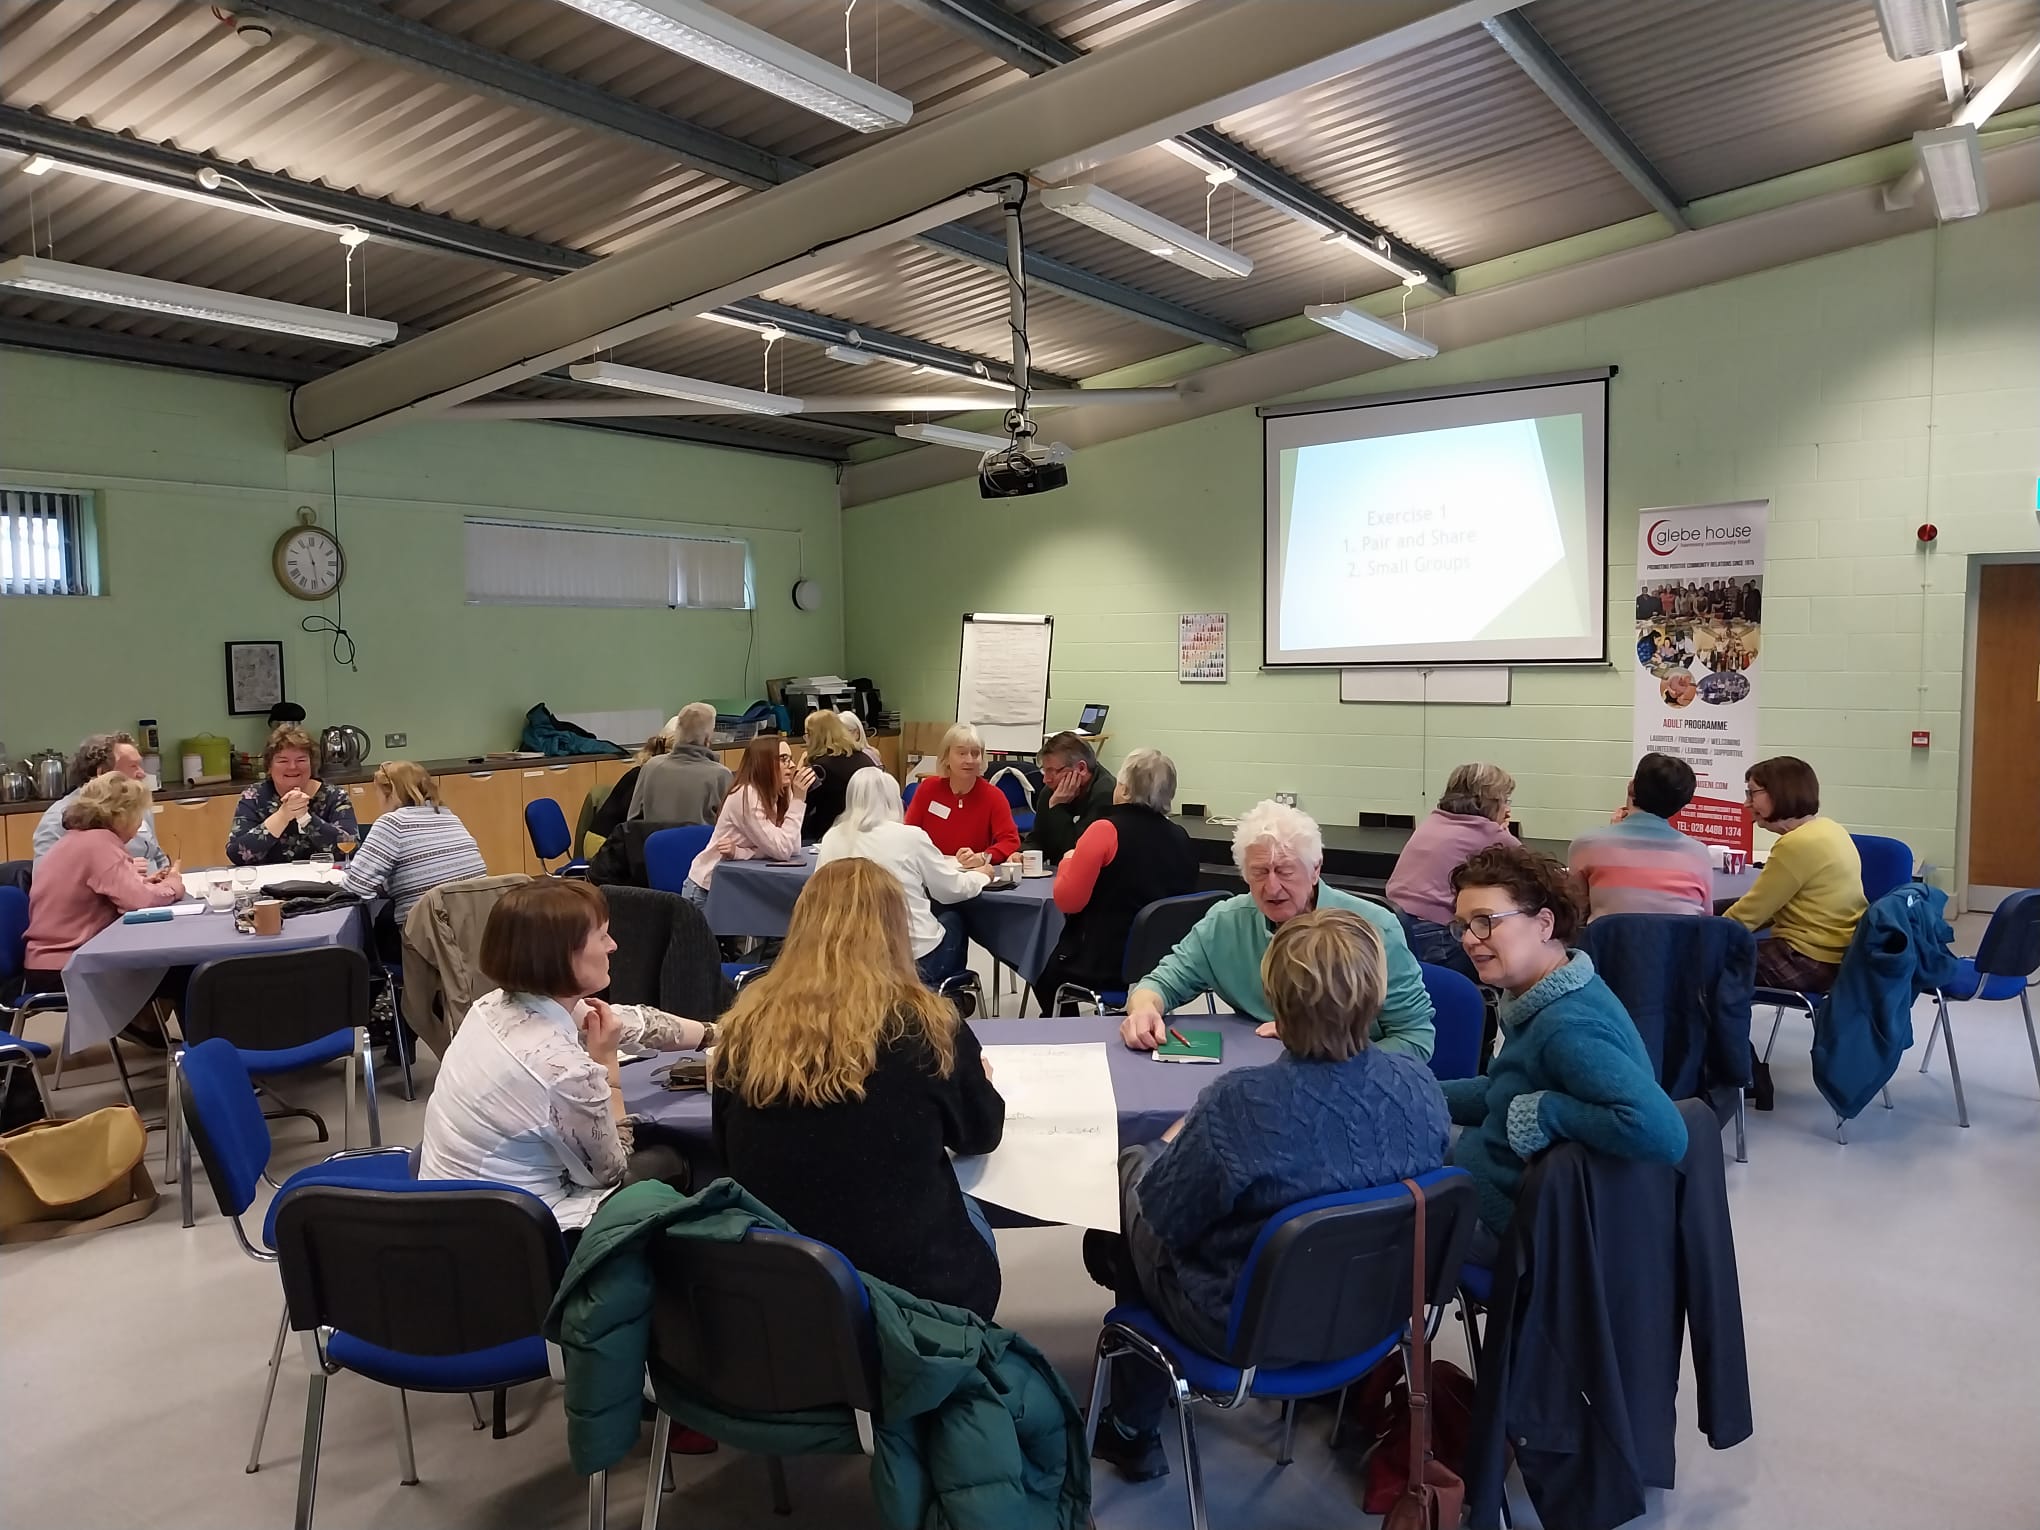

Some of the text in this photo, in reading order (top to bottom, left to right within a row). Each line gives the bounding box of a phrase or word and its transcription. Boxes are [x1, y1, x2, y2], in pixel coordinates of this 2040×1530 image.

[1367, 504, 1447, 527] Exercise 1
[1362, 534, 1391, 552] Pair
[1397, 530, 1425, 549] and
[1431, 529, 1479, 546] Share
[1657, 525, 1752, 546] glebe house
[1368, 559, 1408, 577] Small
[1415, 556, 1472, 575] Groups
[1663, 718, 1728, 731] ADULT PROGRAMME
[1649, 735, 1674, 743] LAUGHTER
[1710, 738, 1741, 747] WELCOMING
[1677, 820, 1690, 832] TEL:
[1690, 822, 1704, 833] 028
[1725, 826, 1742, 837] 1374
